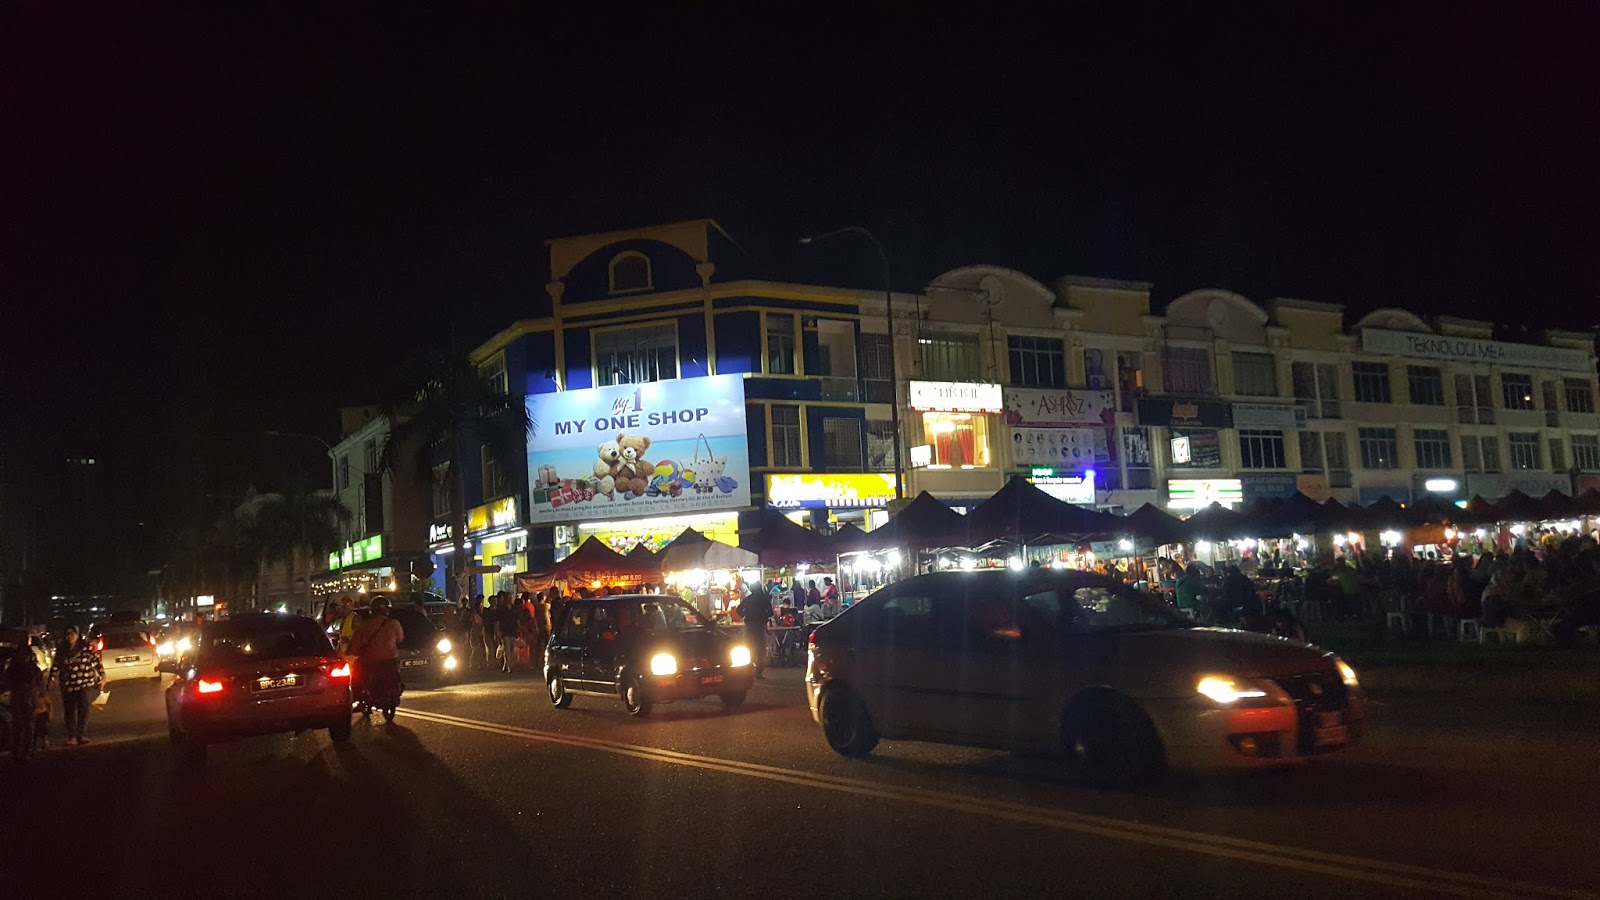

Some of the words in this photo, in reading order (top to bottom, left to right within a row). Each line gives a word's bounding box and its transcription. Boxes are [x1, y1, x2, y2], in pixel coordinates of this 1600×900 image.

[555, 419, 586, 435] MY
[594, 414, 640, 431] ONE
[648, 407, 709, 426] SHOP
[260, 680, 276, 690] BPC
[276, 677, 296, 688] 2349
